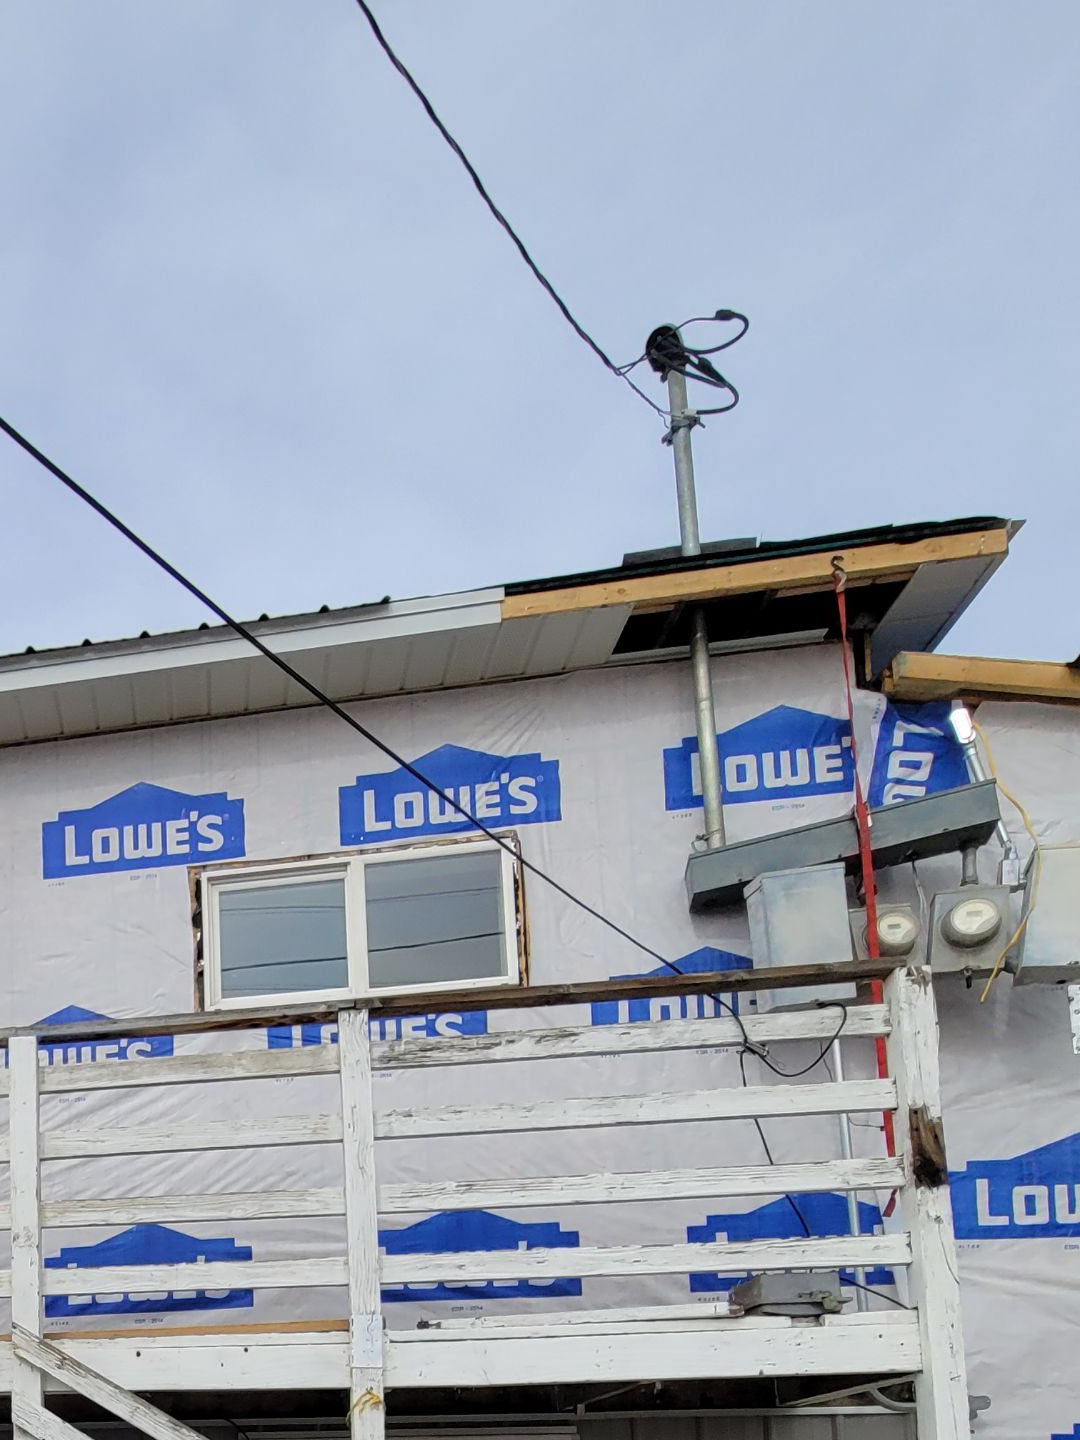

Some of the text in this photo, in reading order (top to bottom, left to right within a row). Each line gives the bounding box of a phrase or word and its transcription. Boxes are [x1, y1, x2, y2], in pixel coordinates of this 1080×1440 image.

[690, 736, 852, 796] LOWE'
[364, 772, 540, 833] LOWE'S
[65, 811, 225, 867] LOWE'S
